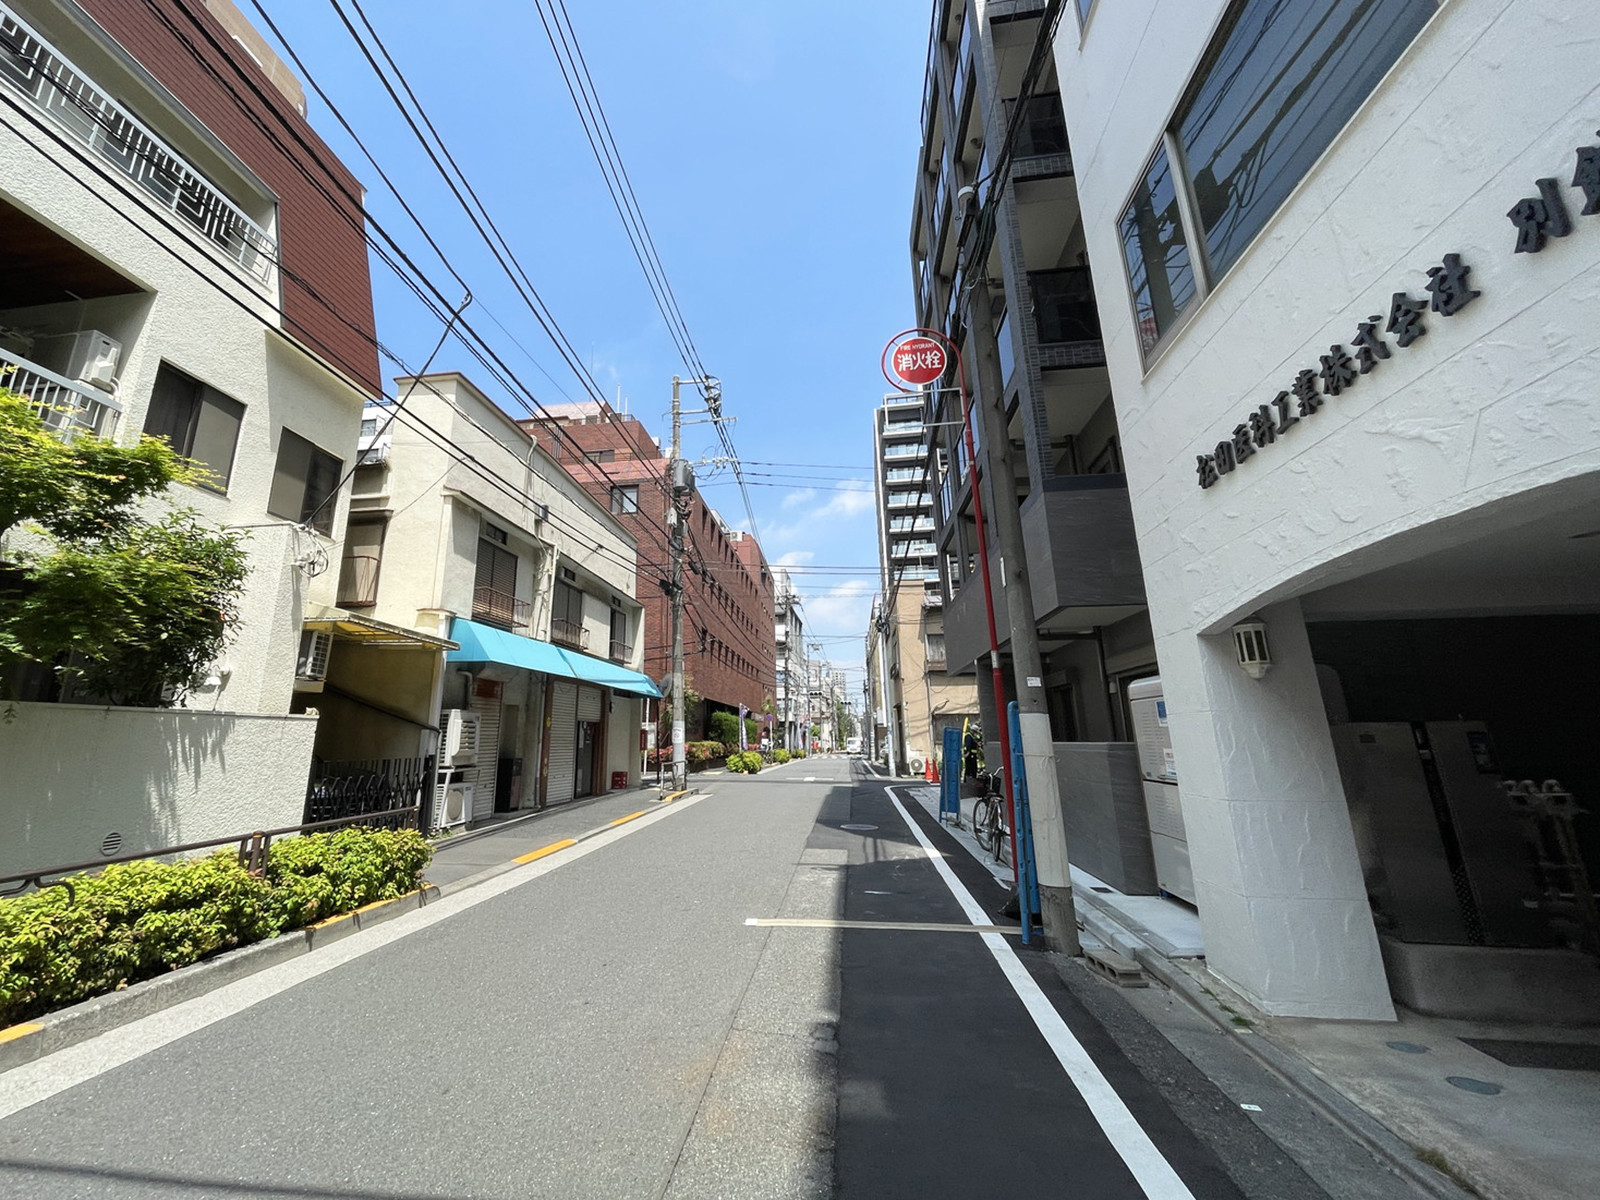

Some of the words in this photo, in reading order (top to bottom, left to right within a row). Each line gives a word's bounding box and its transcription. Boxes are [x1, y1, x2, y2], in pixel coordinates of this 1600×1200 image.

[897, 350, 942, 372] 消火栓
[1196, 253, 1481, 489] 松田医科工業株式会社
